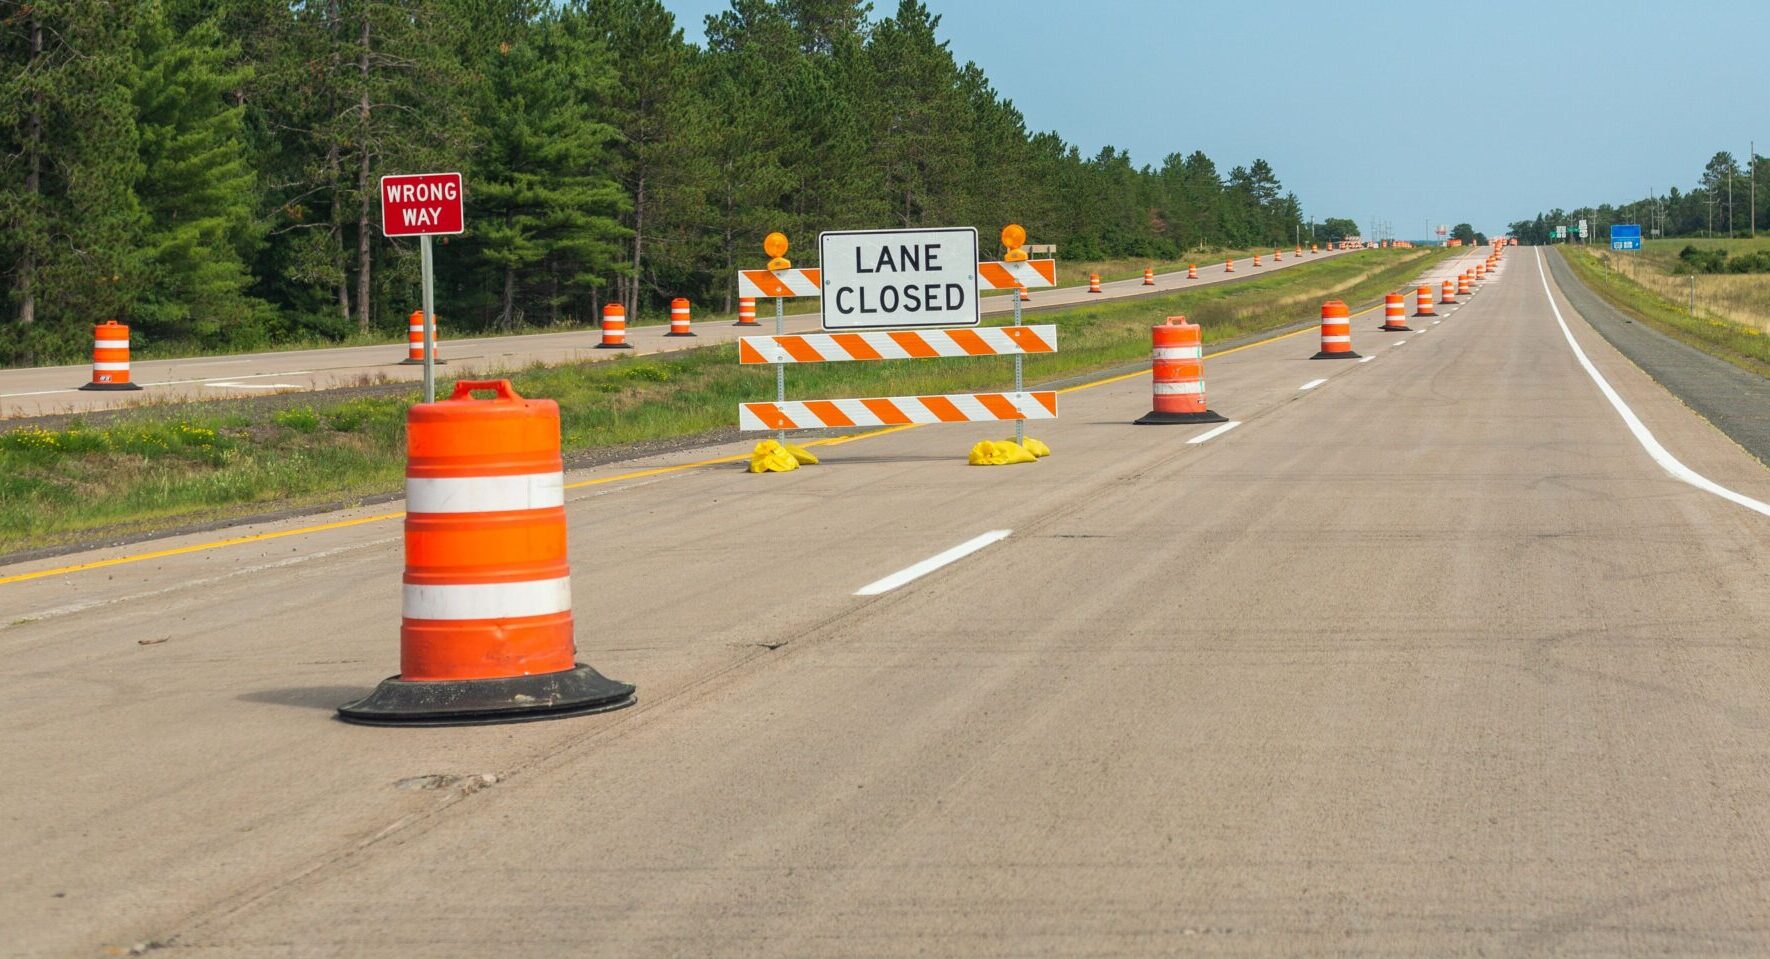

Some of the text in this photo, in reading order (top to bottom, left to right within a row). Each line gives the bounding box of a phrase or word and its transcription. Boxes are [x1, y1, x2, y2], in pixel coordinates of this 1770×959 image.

[386, 182, 457, 203] WRONG
[402, 207, 442, 226] WAY
[856, 244, 942, 273] LANE
[836, 283, 965, 314] CLOSED
